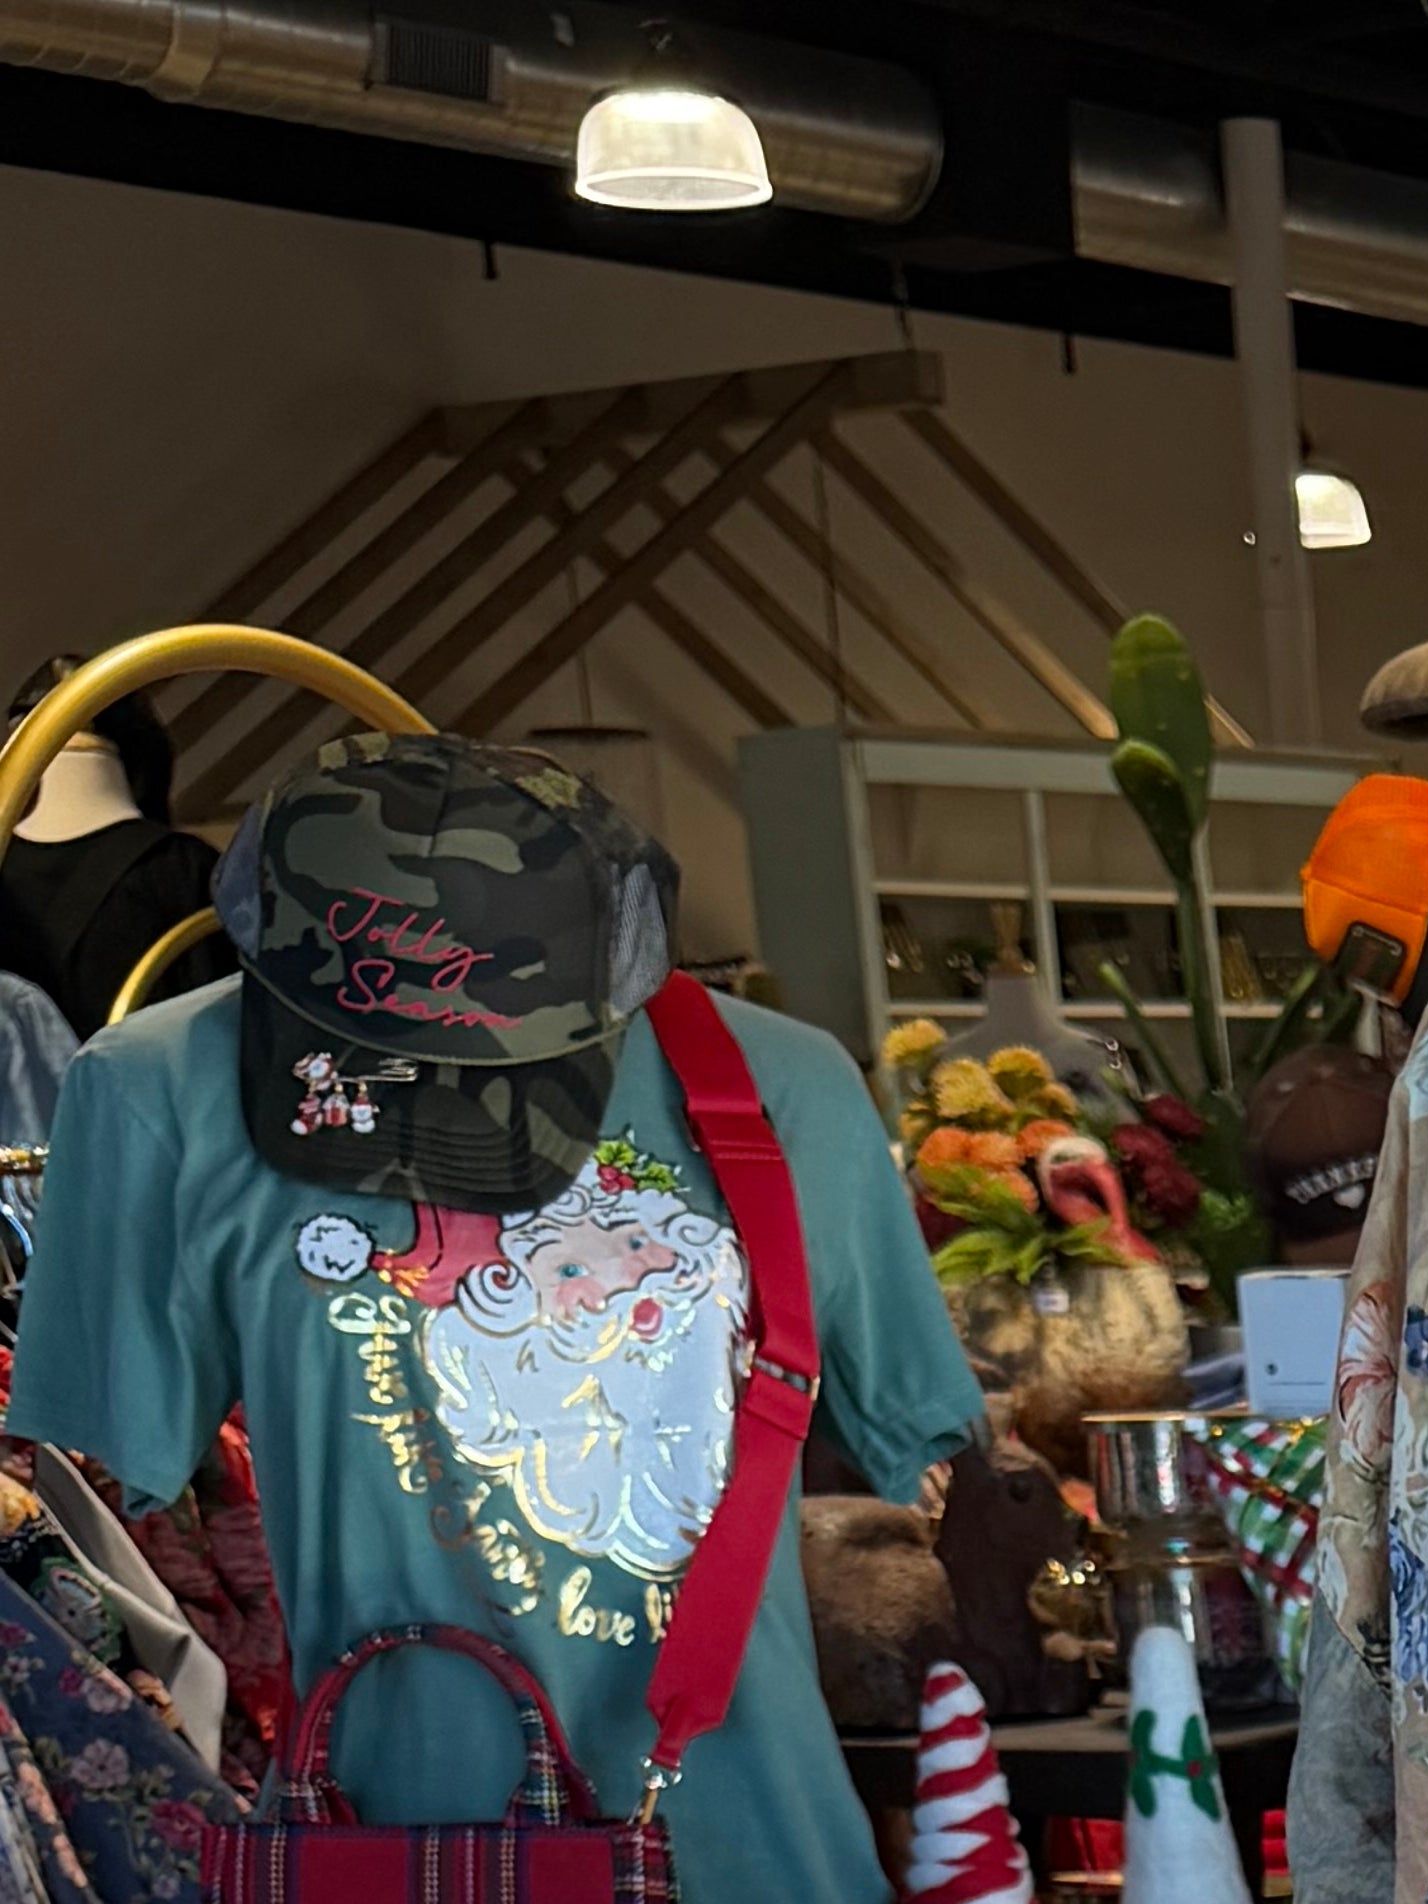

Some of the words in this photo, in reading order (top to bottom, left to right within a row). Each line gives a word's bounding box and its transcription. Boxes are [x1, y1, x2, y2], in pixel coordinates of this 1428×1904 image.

[327, 887, 494, 993] Jolly
[336, 958, 524, 1030] Season
[558, 1565, 635, 1646] love
